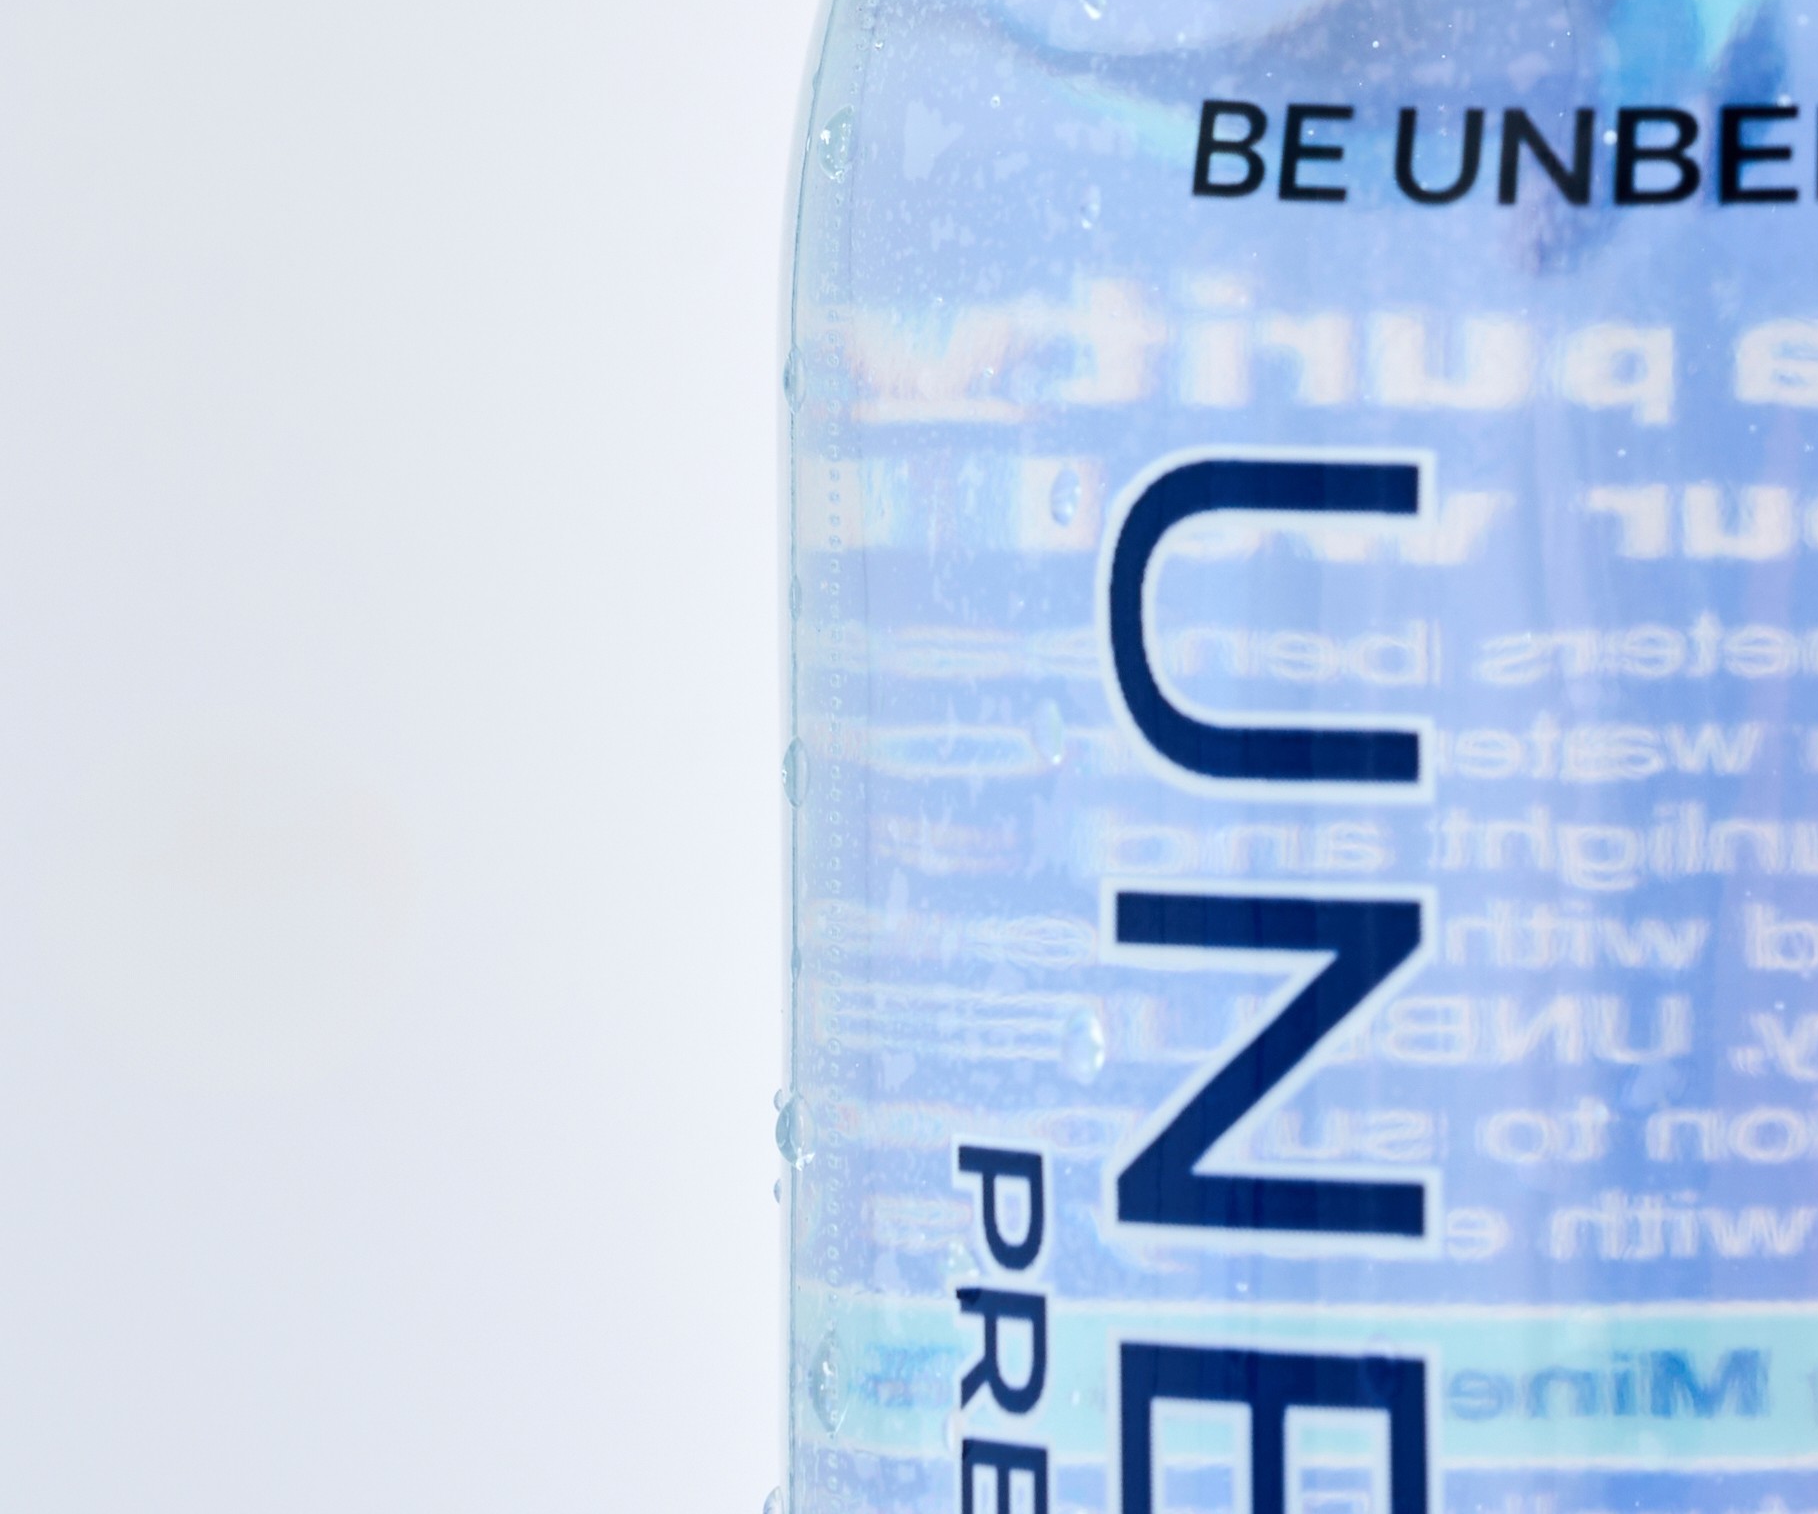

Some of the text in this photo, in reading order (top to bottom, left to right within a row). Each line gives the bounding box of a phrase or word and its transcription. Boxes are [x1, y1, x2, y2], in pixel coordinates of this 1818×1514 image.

[1190, 98, 1352, 201] BE
[1107, 454, 1429, 1514] UNE
[955, 1144, 1050, 1514] PRE
